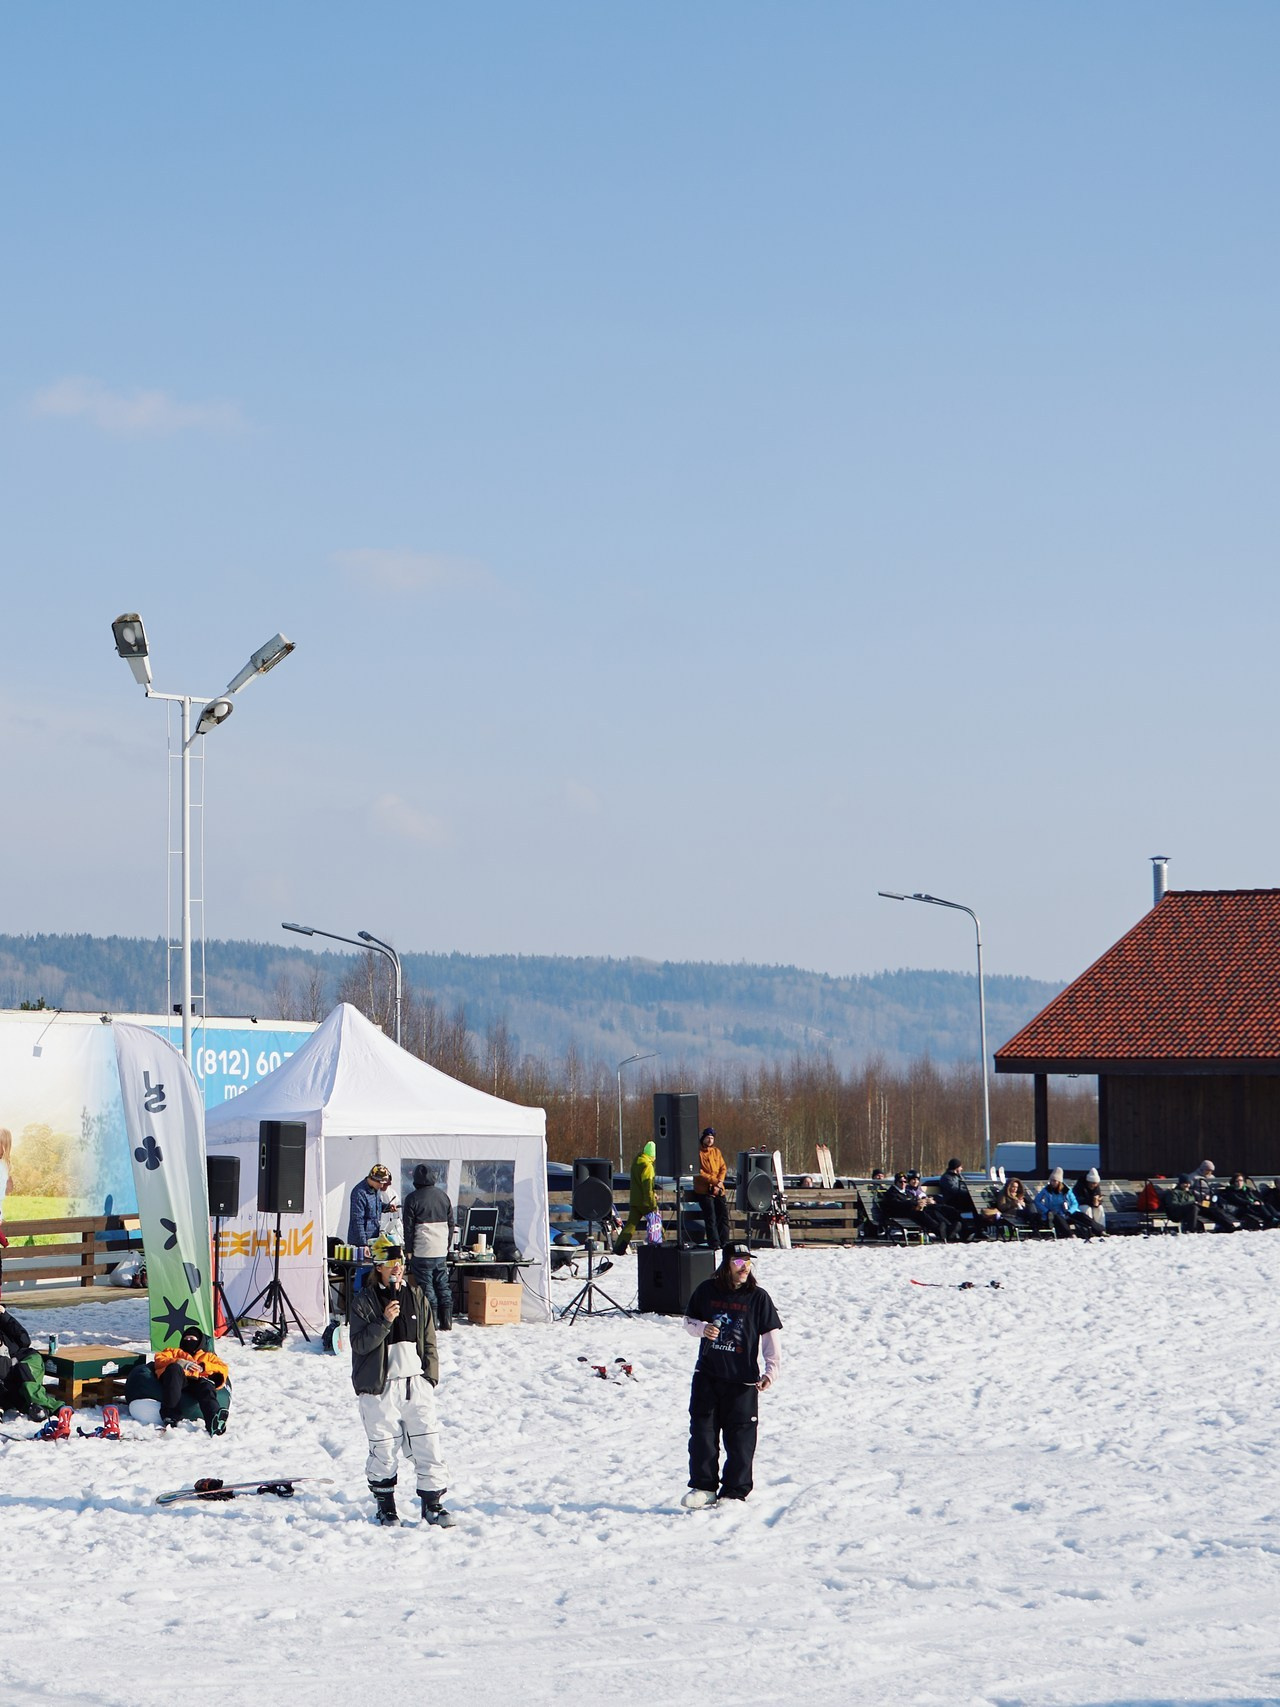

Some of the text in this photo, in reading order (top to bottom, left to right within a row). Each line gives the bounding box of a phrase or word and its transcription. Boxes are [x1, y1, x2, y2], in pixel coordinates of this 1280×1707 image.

[196, 1047, 293, 1080] (812) 60
[219, 1220, 314, 1257] ЕЖНЫЙ
